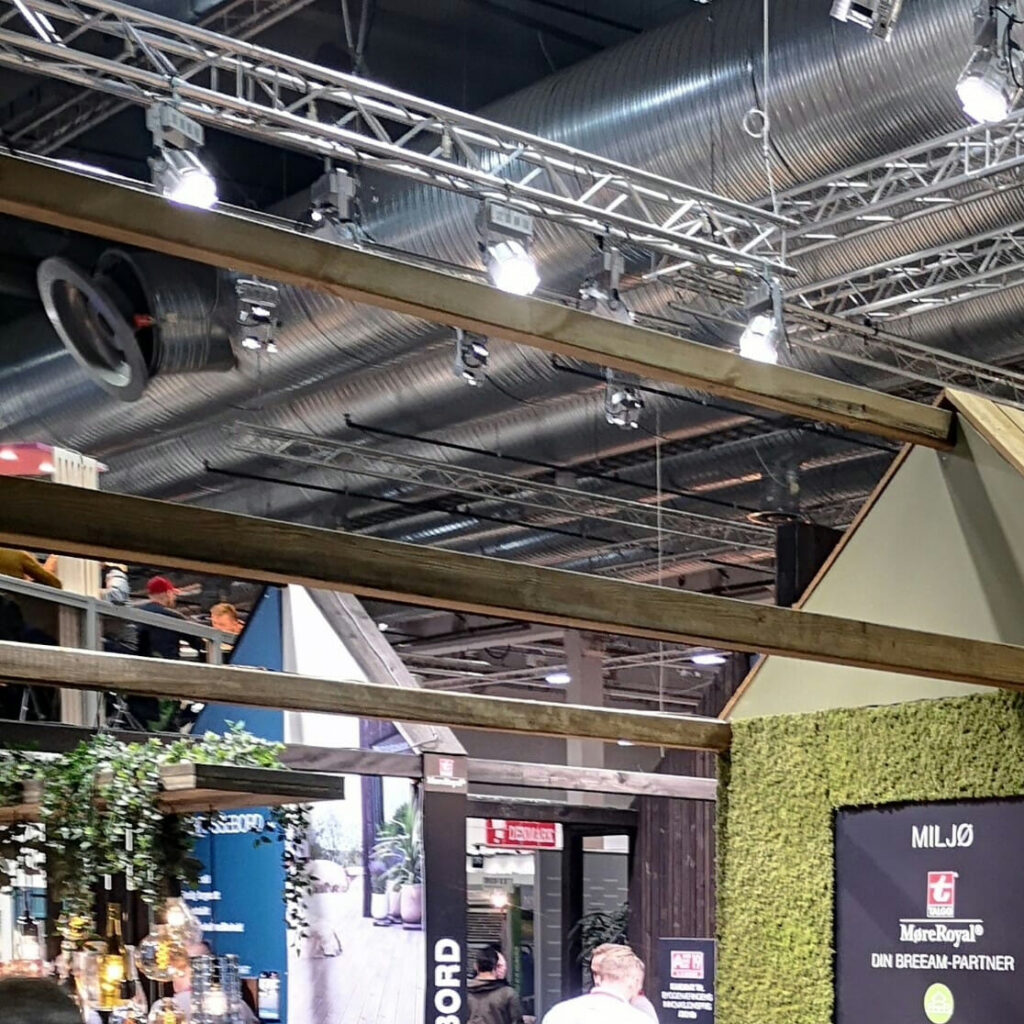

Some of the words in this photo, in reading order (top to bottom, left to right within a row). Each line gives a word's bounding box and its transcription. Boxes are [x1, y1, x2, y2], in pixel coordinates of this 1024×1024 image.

[911, 823, 975, 848] MILJØ
[871, 953, 893, 968] DIN
[895, 953, 1015, 972] BREEAM-PARTNER
